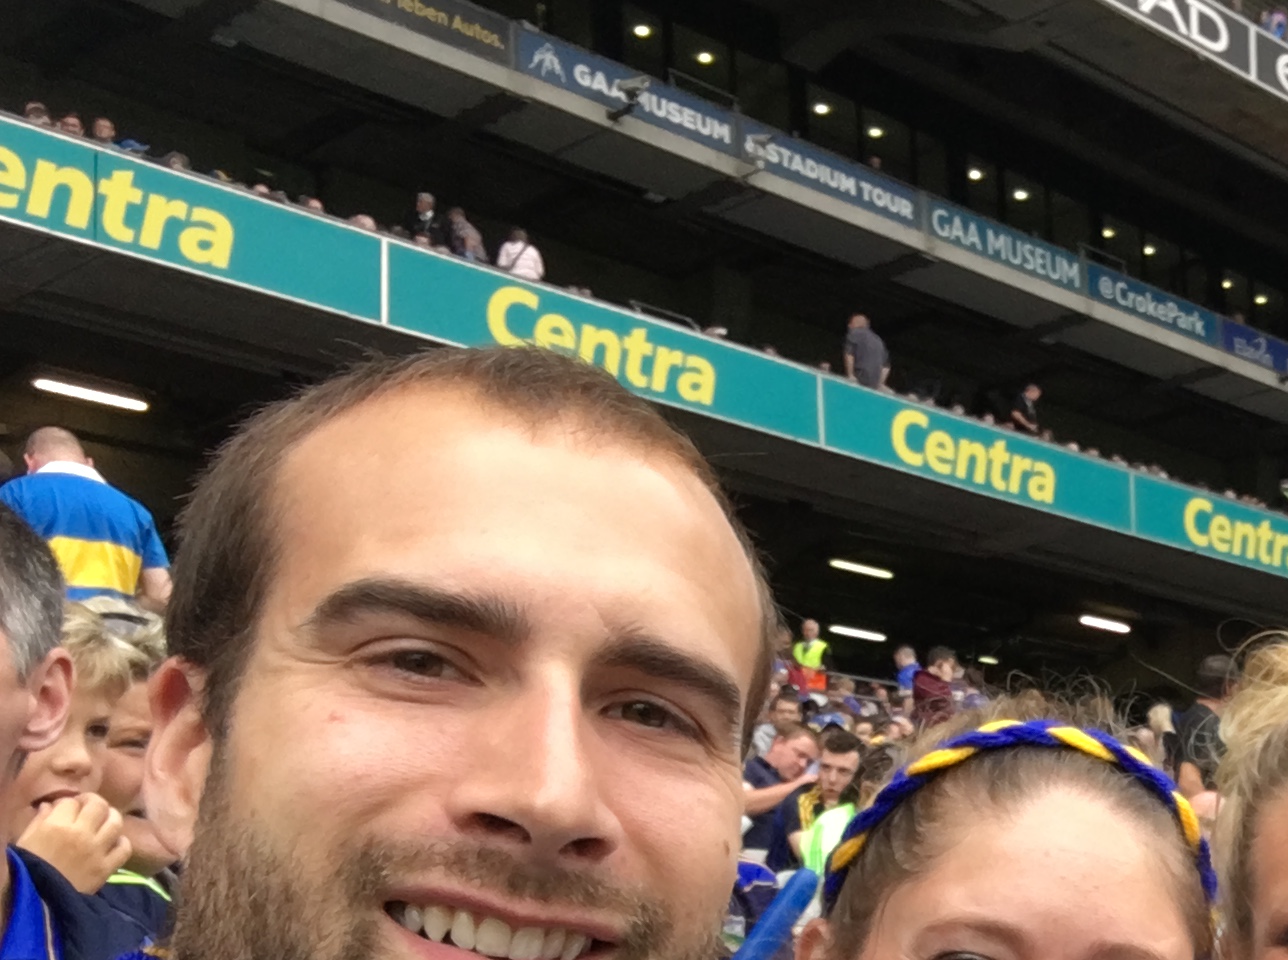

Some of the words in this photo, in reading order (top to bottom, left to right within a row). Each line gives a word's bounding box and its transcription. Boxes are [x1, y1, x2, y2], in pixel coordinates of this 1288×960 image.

[765, 143, 857, 196] STADIUM
[859, 181, 914, 219] TOUR
[932, 209, 983, 250] GAA
[987, 229, 1081, 288] MUSEUM
[486, 285, 716, 405] Centra
[1098, 276, 1206, 337] @CrokePark
[890, 409, 1056, 504] Centra
